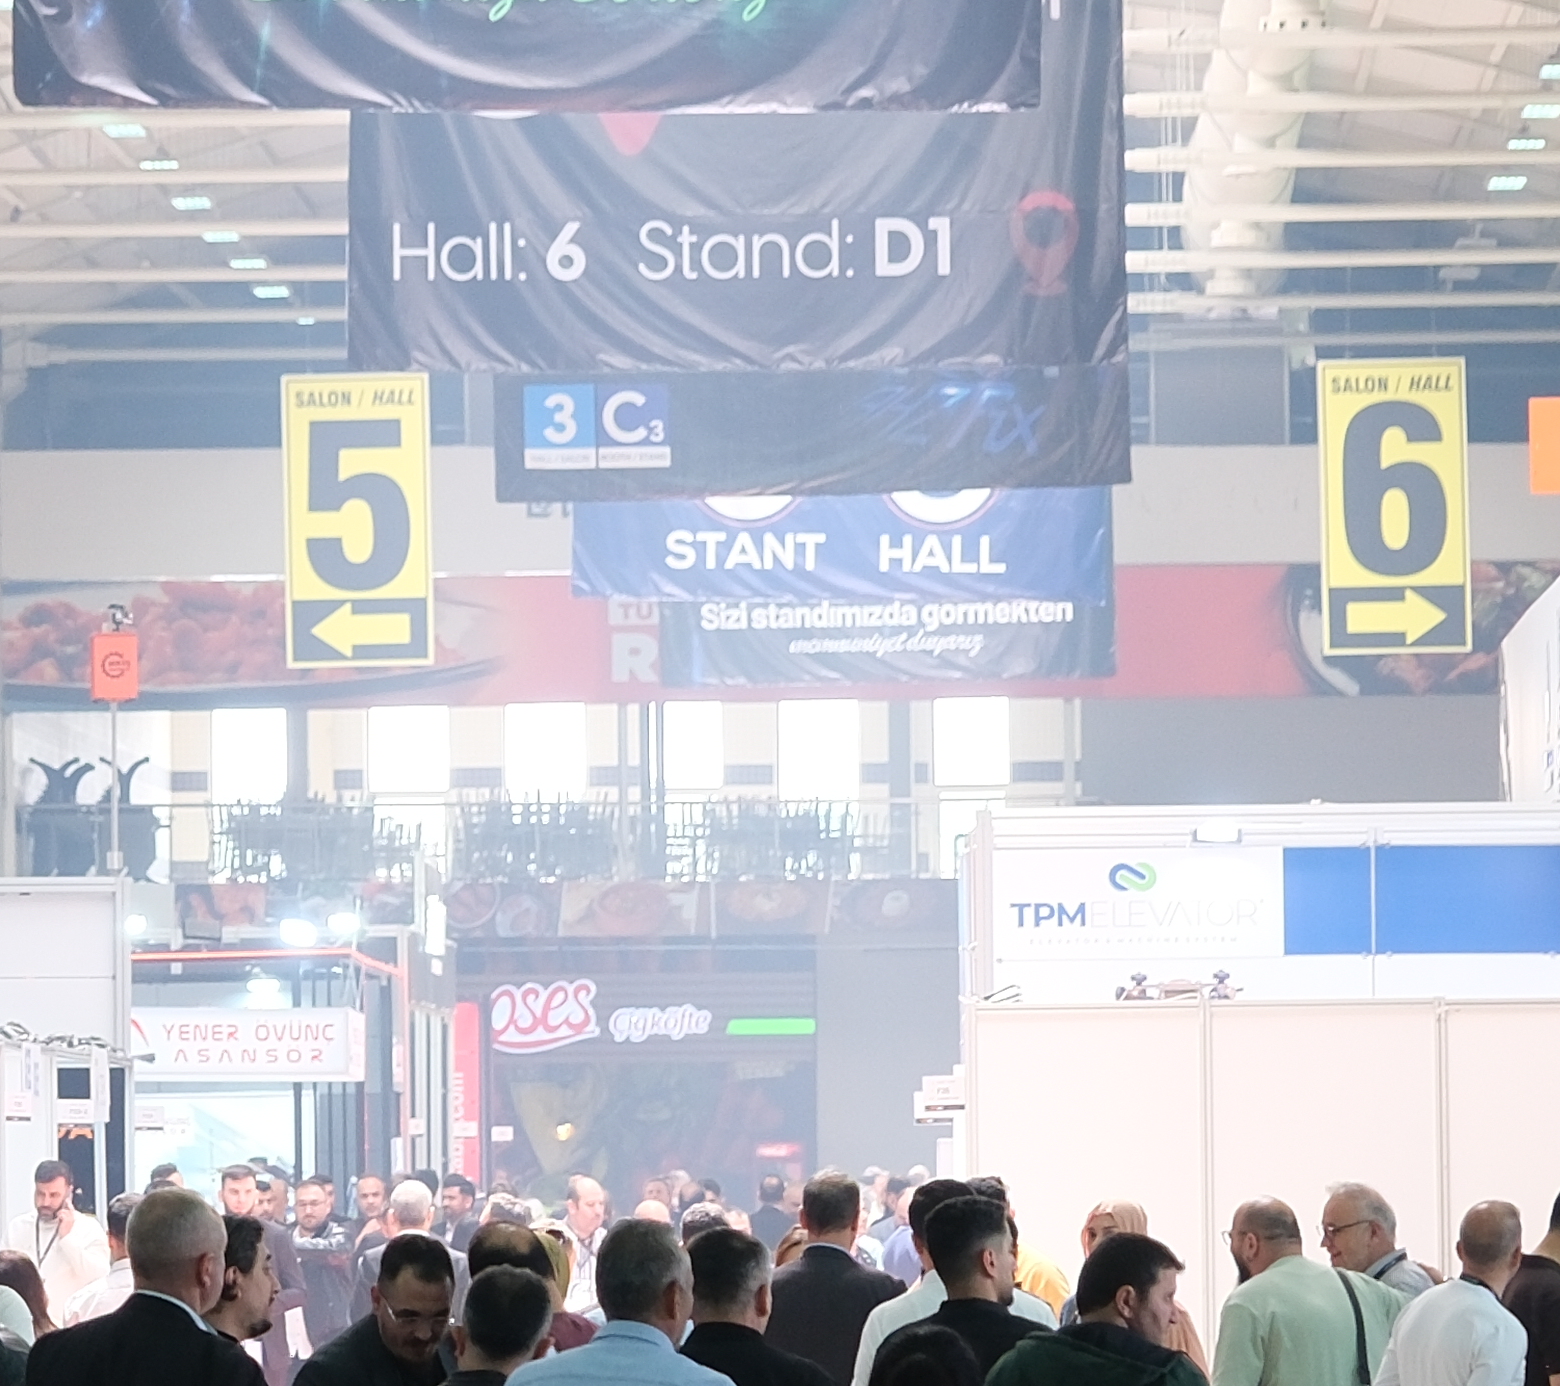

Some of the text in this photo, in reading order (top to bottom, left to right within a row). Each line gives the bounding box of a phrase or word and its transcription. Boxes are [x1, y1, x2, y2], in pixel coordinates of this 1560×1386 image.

[391, 217, 952, 281] Hall: 6 Stand: D1
[294, 390, 354, 410] SALON
[371, 388, 416, 408] HALL
[1331, 376, 1390, 394] SALON
[1408, 374, 1455, 392] HALL
[543, 391, 578, 445] 3
[307, 419, 411, 592] 5
[1341, 400, 1449, 578] 6
[664, 529, 826, 572] STANT
[878, 534, 1007, 574] HALL
[162, 1023, 240, 1041] YENER
